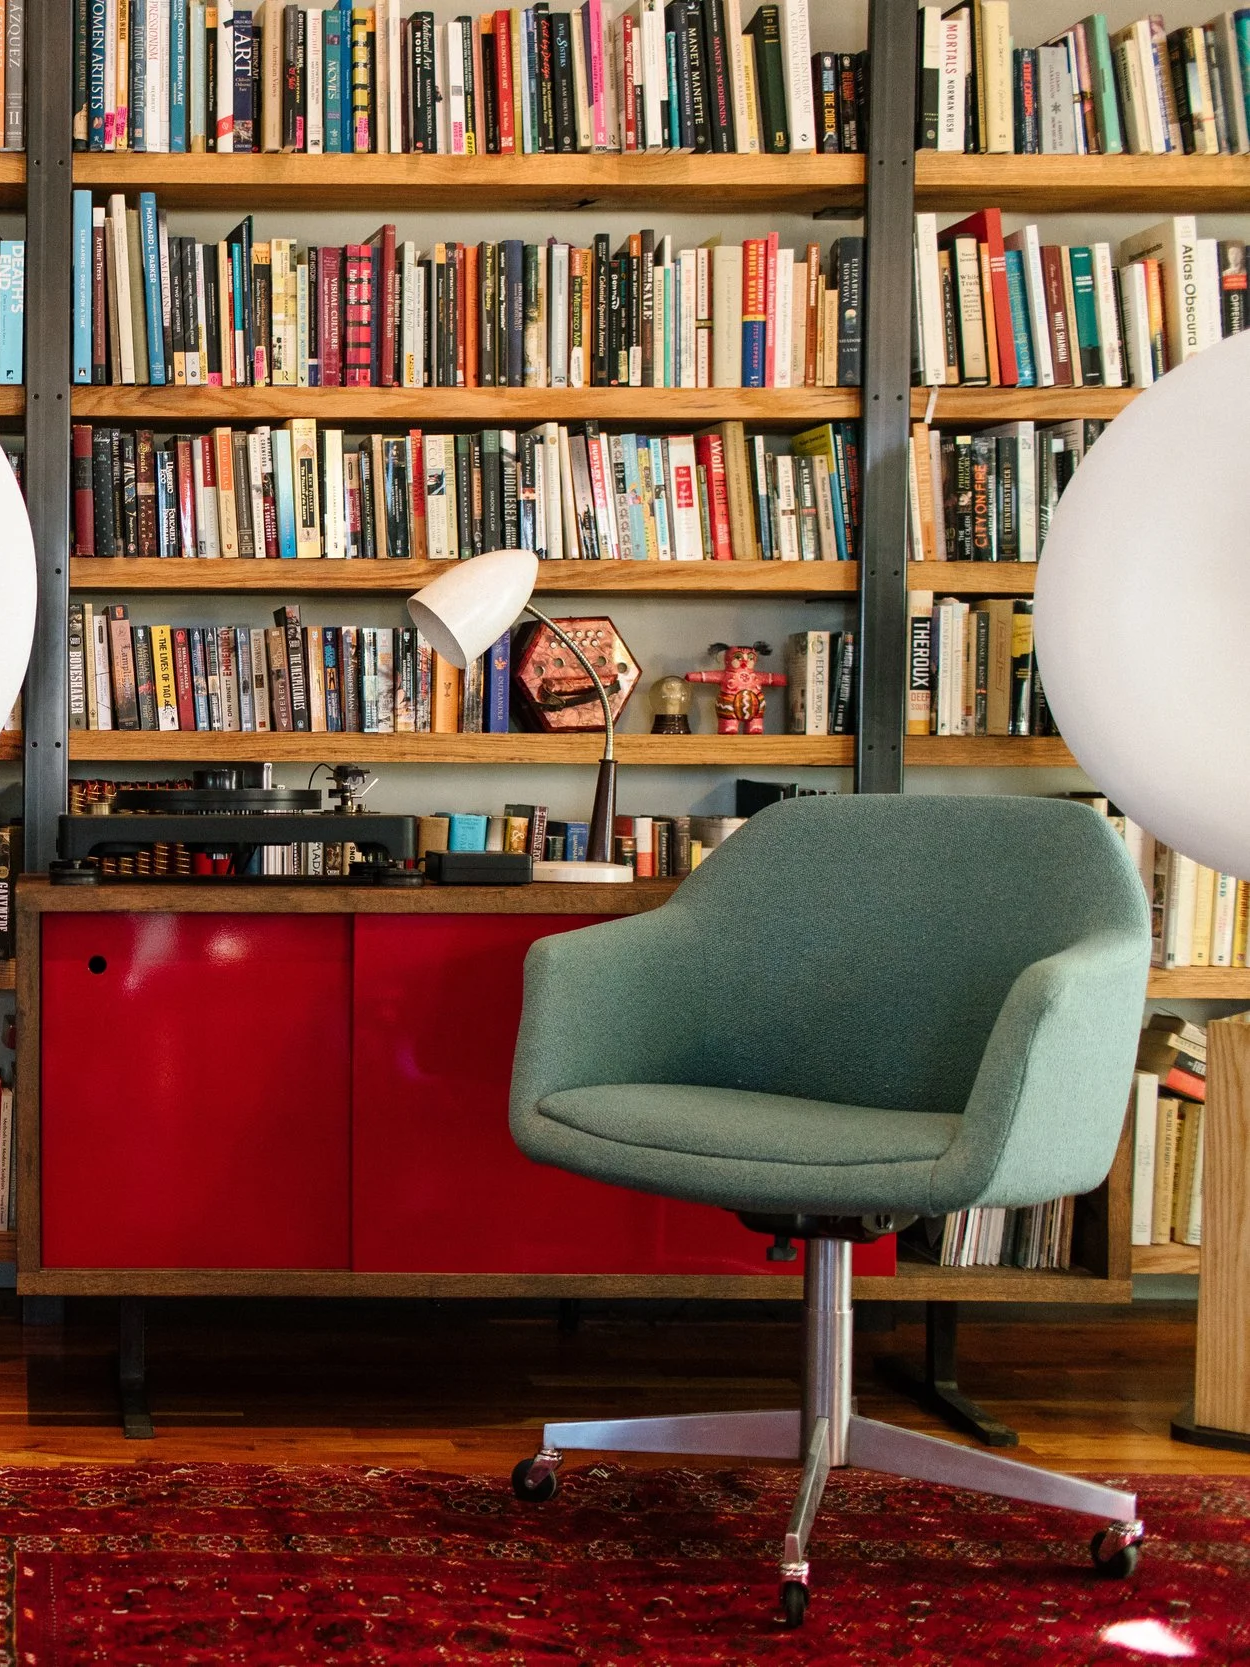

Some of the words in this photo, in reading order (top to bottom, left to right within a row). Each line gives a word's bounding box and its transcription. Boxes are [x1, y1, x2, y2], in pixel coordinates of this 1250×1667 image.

[311, 17, 320, 55] Foucault
[421, 16, 432, 52] Medieval
[688, 28, 699, 67] MANET
[945, 24, 958, 75] MORTALS
[233, 31, 253, 77] ART
[271, 44, 280, 76] American
[422, 54, 432, 69] Art
[713, 36, 722, 72] MANET'S
[91, 54, 104, 108] ARTISTS
[176, 55, 185, 88] EUROPEAN
[326, 60, 336, 99] MOVIES
[272, 79, 280, 97] Views
[626, 77, 635, 119] Consciousness
[691, 71, 704, 124] MANETTE
[716, 75, 727, 126] MODERNISM
[824, 93, 836, 105] THE
[946, 80, 955, 110] NORMAN
[825, 108, 836, 132] CODEX
[946, 114, 956, 132] RUSH
[145, 207, 155, 244] MAYNARD
[96, 236, 104, 259] Arthur
[748, 243, 757, 277] WONDER
[810, 246, 818, 280] Architectural
[1182, 244, 1194, 281] Atlas
[0, 254, 12, 291] END
[11, 244, 24, 314] DEATH'S
[96, 262, 104, 281] Tress
[148, 254, 157, 284] PARKER
[309, 262, 317, 282] HISTORY
[387, 270, 395, 293] Sisters
[842, 262, 850, 303] KOSTOVA
[851, 258, 859, 307] ELIZABETH
[331, 278, 339, 307] VISUAL
[349, 284, 359, 305] Trouble
[359, 269, 370, 304] Representing
[484, 287, 493, 311] Display
[598, 275, 607, 303] Colonial
[643, 283, 654, 320] SALE
[748, 279, 757, 312] WOMAN
[809, 280, 817, 307] Ornament
[386, 315, 395, 339] Brush
[573, 292, 581, 330] MESTIZO
[596, 304, 607, 331] Spanish
[1053, 311, 1063, 331] WHITE
[1184, 282, 1199, 346] Obscura
[331, 310, 339, 350] CULTURE
[597, 331, 606, 357] America
[1055, 331, 1068, 363] SHANGHAI
[112, 433, 120, 456] SARAH
[139, 443, 152, 473] Dracula
[711, 440, 724, 474] Wolf
[113, 457, 122, 486] VOWELL
[165, 462, 174, 493] UMBERTO
[974, 464, 988, 494] FIRE
[503, 466, 517, 522] MIDDLESEX
[973, 495, 989, 514] ON
[1002, 468, 1012, 533] THUNDERSTRUCK
[973, 519, 989, 549] CITY
[1040, 504, 1053, 541] Them
[158, 637, 167, 651] THE
[912, 620, 930, 687] THEROUX
[159, 652, 169, 671] LIVES
[815, 659, 825, 686] EDGE
[69, 650, 84, 714] BONESHAKER
[162, 684, 170, 699] TAO
[497, 676, 505, 721] OUTLANDER
[0, 1117, 8, 1137] Methods
